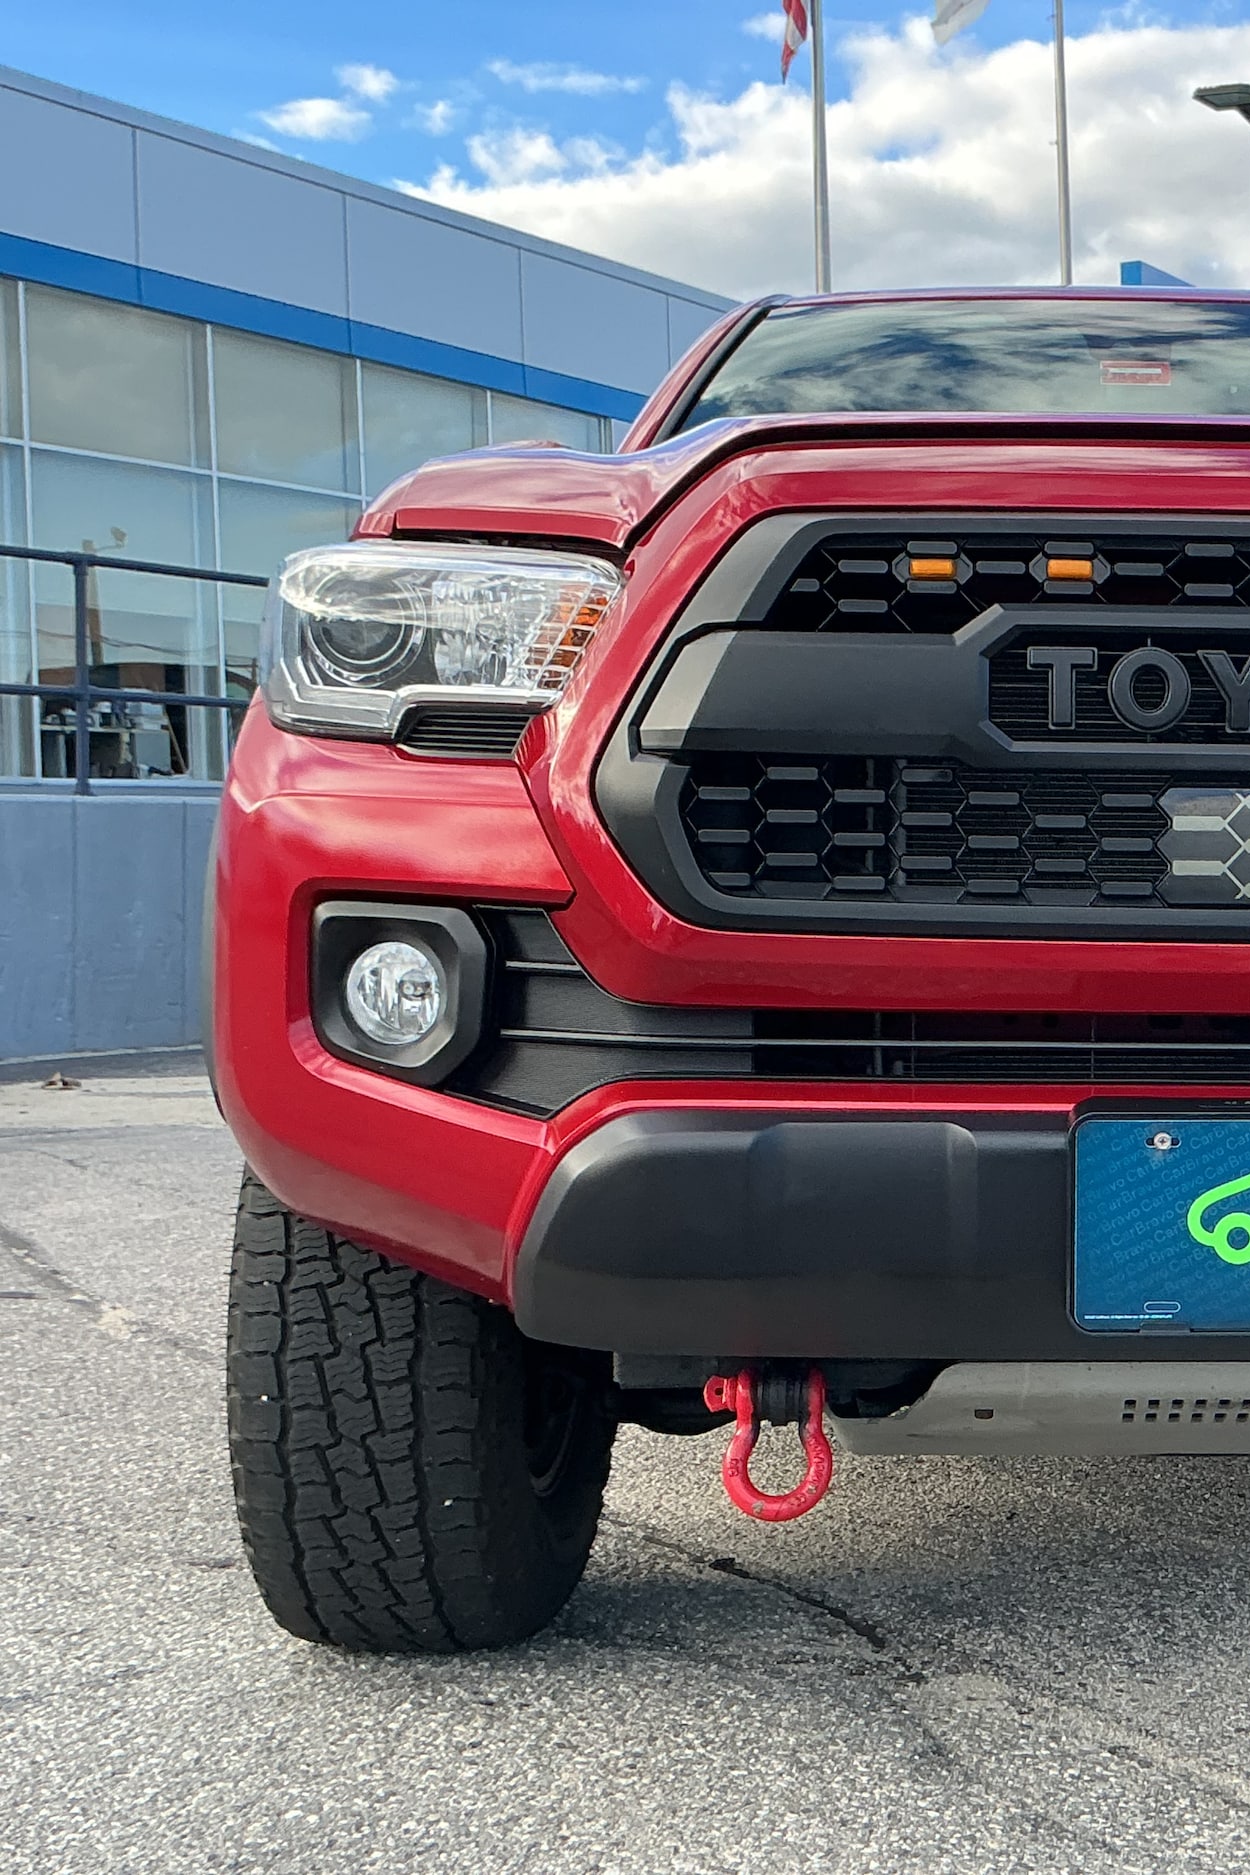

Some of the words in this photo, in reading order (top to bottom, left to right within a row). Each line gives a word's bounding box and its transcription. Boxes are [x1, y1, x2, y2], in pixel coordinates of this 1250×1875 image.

[1161, 1147, 1225, 1183] CarBravo
[1141, 1175, 1205, 1212] CarBravo
[1110, 1209, 1175, 1246] CarBravo
